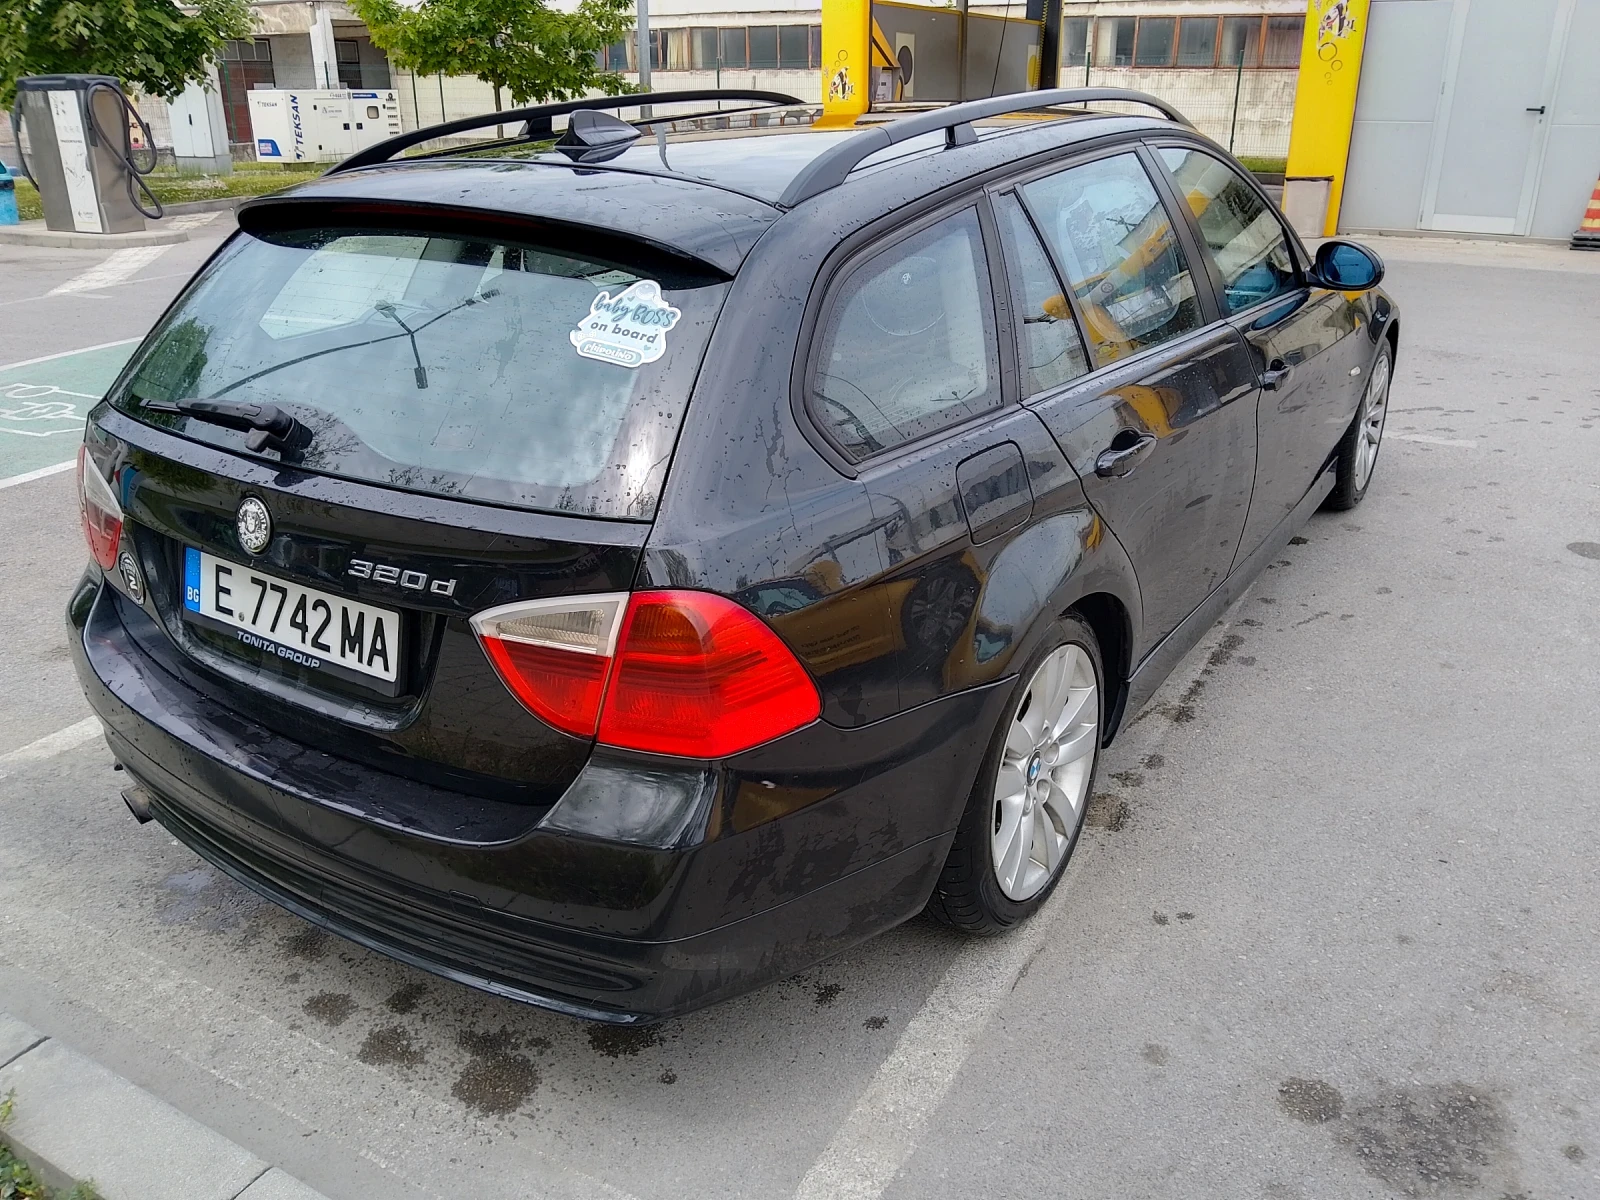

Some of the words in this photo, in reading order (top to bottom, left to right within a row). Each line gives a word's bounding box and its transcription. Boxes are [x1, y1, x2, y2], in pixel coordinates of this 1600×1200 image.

[290, 94, 304, 144] TEKSAN
[593, 293, 633, 323] baby
[632, 303, 677, 328] BOSS
[590, 321, 608, 332] on
[611, 323, 659, 344] board
[186, 585, 200, 604] BG
[236, 630, 277, 654] TONITA
[277, 646, 321, 669] GROUP
